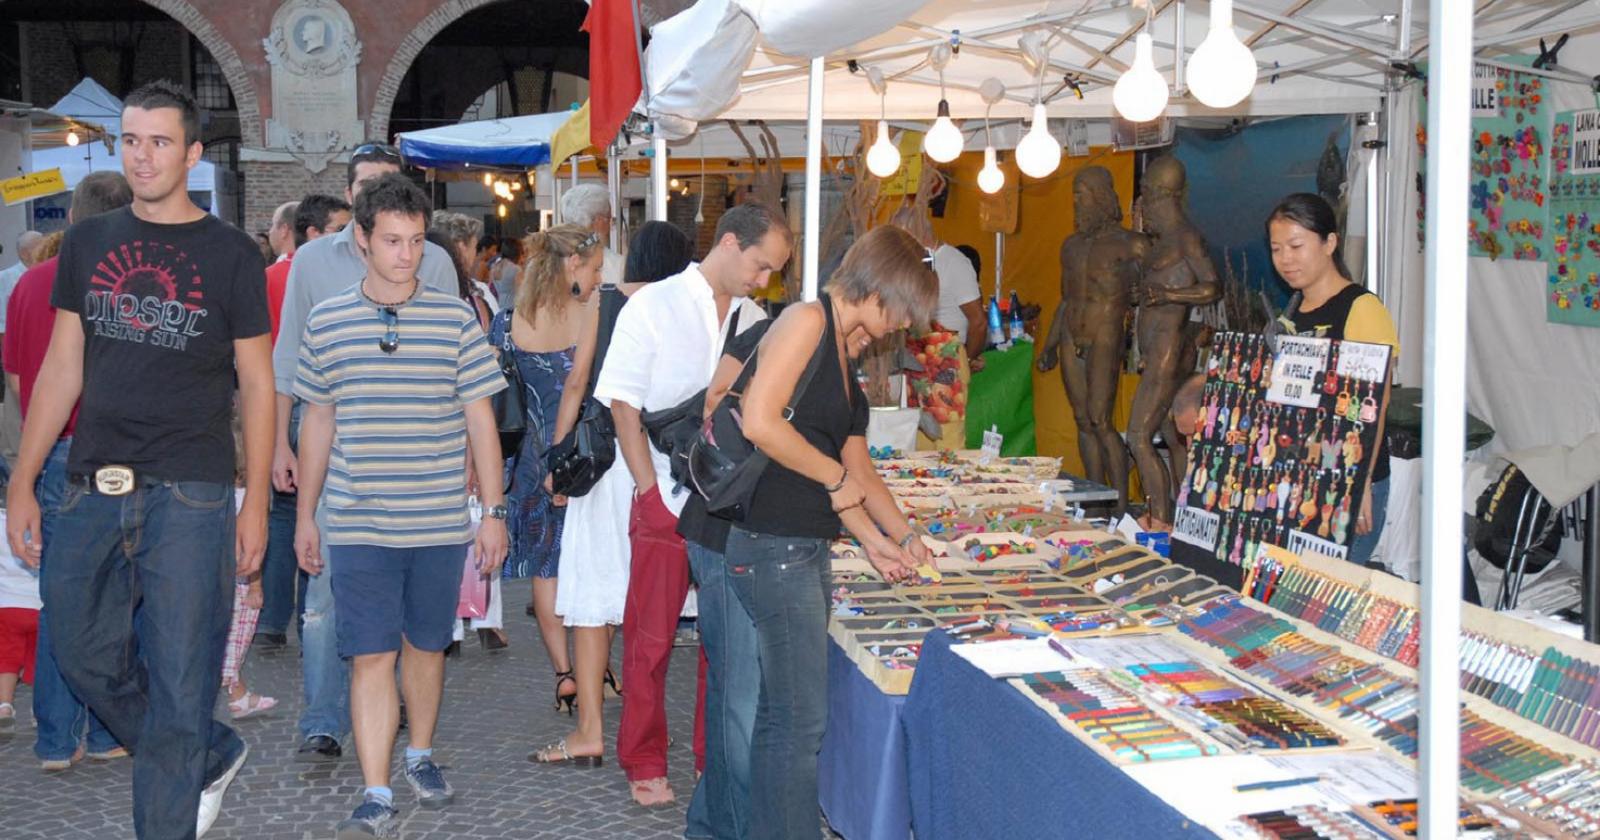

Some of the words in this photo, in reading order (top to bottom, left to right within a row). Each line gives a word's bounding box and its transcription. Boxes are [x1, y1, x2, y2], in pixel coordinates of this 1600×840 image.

[150, 329, 188, 352] SUN
[1292, 364, 1313, 381] PELLE
[1175, 508, 1217, 544] ARTIGIANATO
